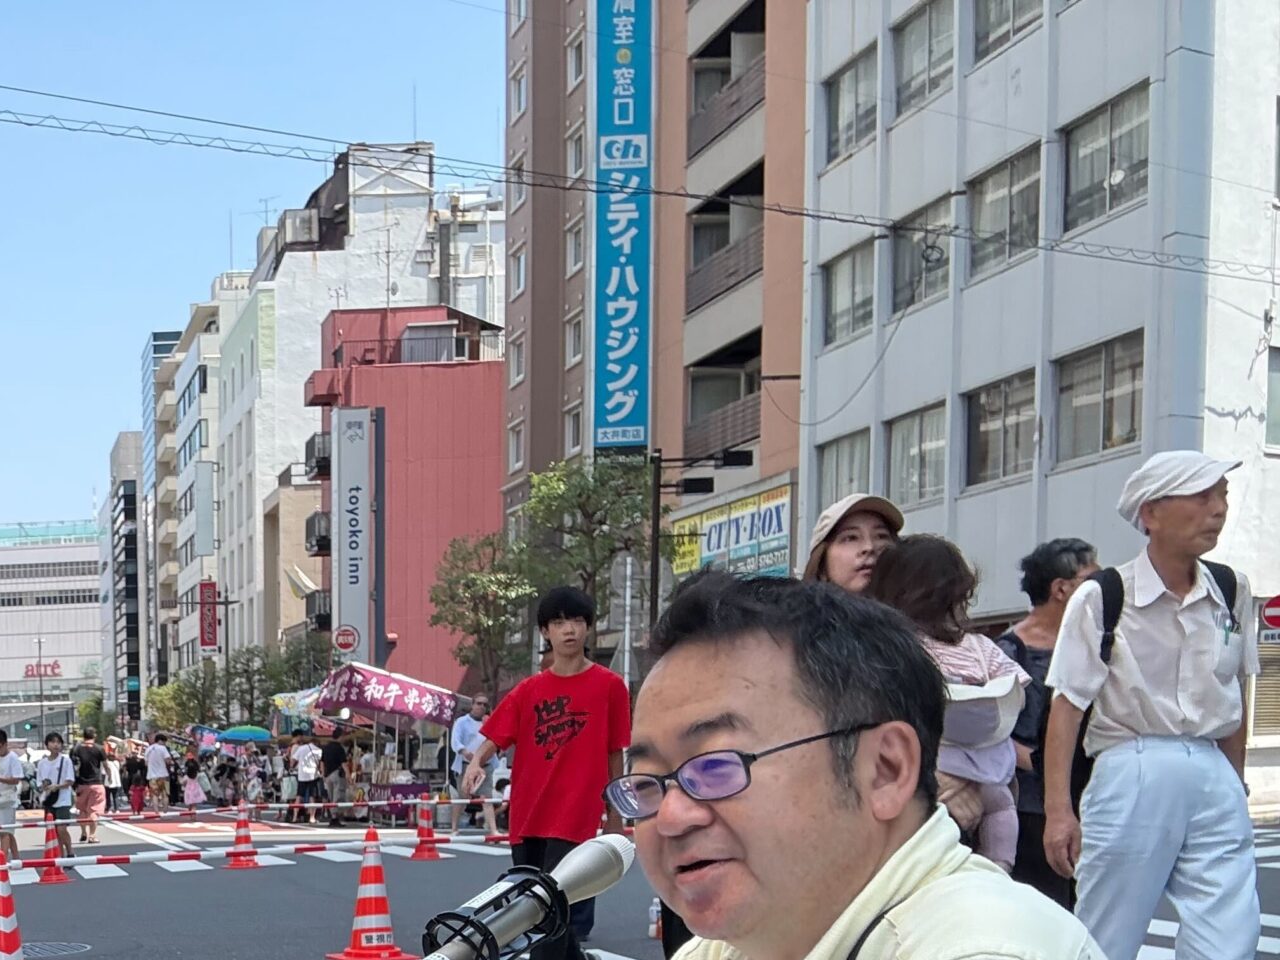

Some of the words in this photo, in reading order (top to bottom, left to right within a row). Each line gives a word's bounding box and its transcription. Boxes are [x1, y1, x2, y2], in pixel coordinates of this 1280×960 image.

[604, 171, 640, 424] シティ・ハウジング
[600, 429, 641, 440] 大井町店
[346, 487, 362, 551] toyoko
[349, 557, 363, 585] inn
